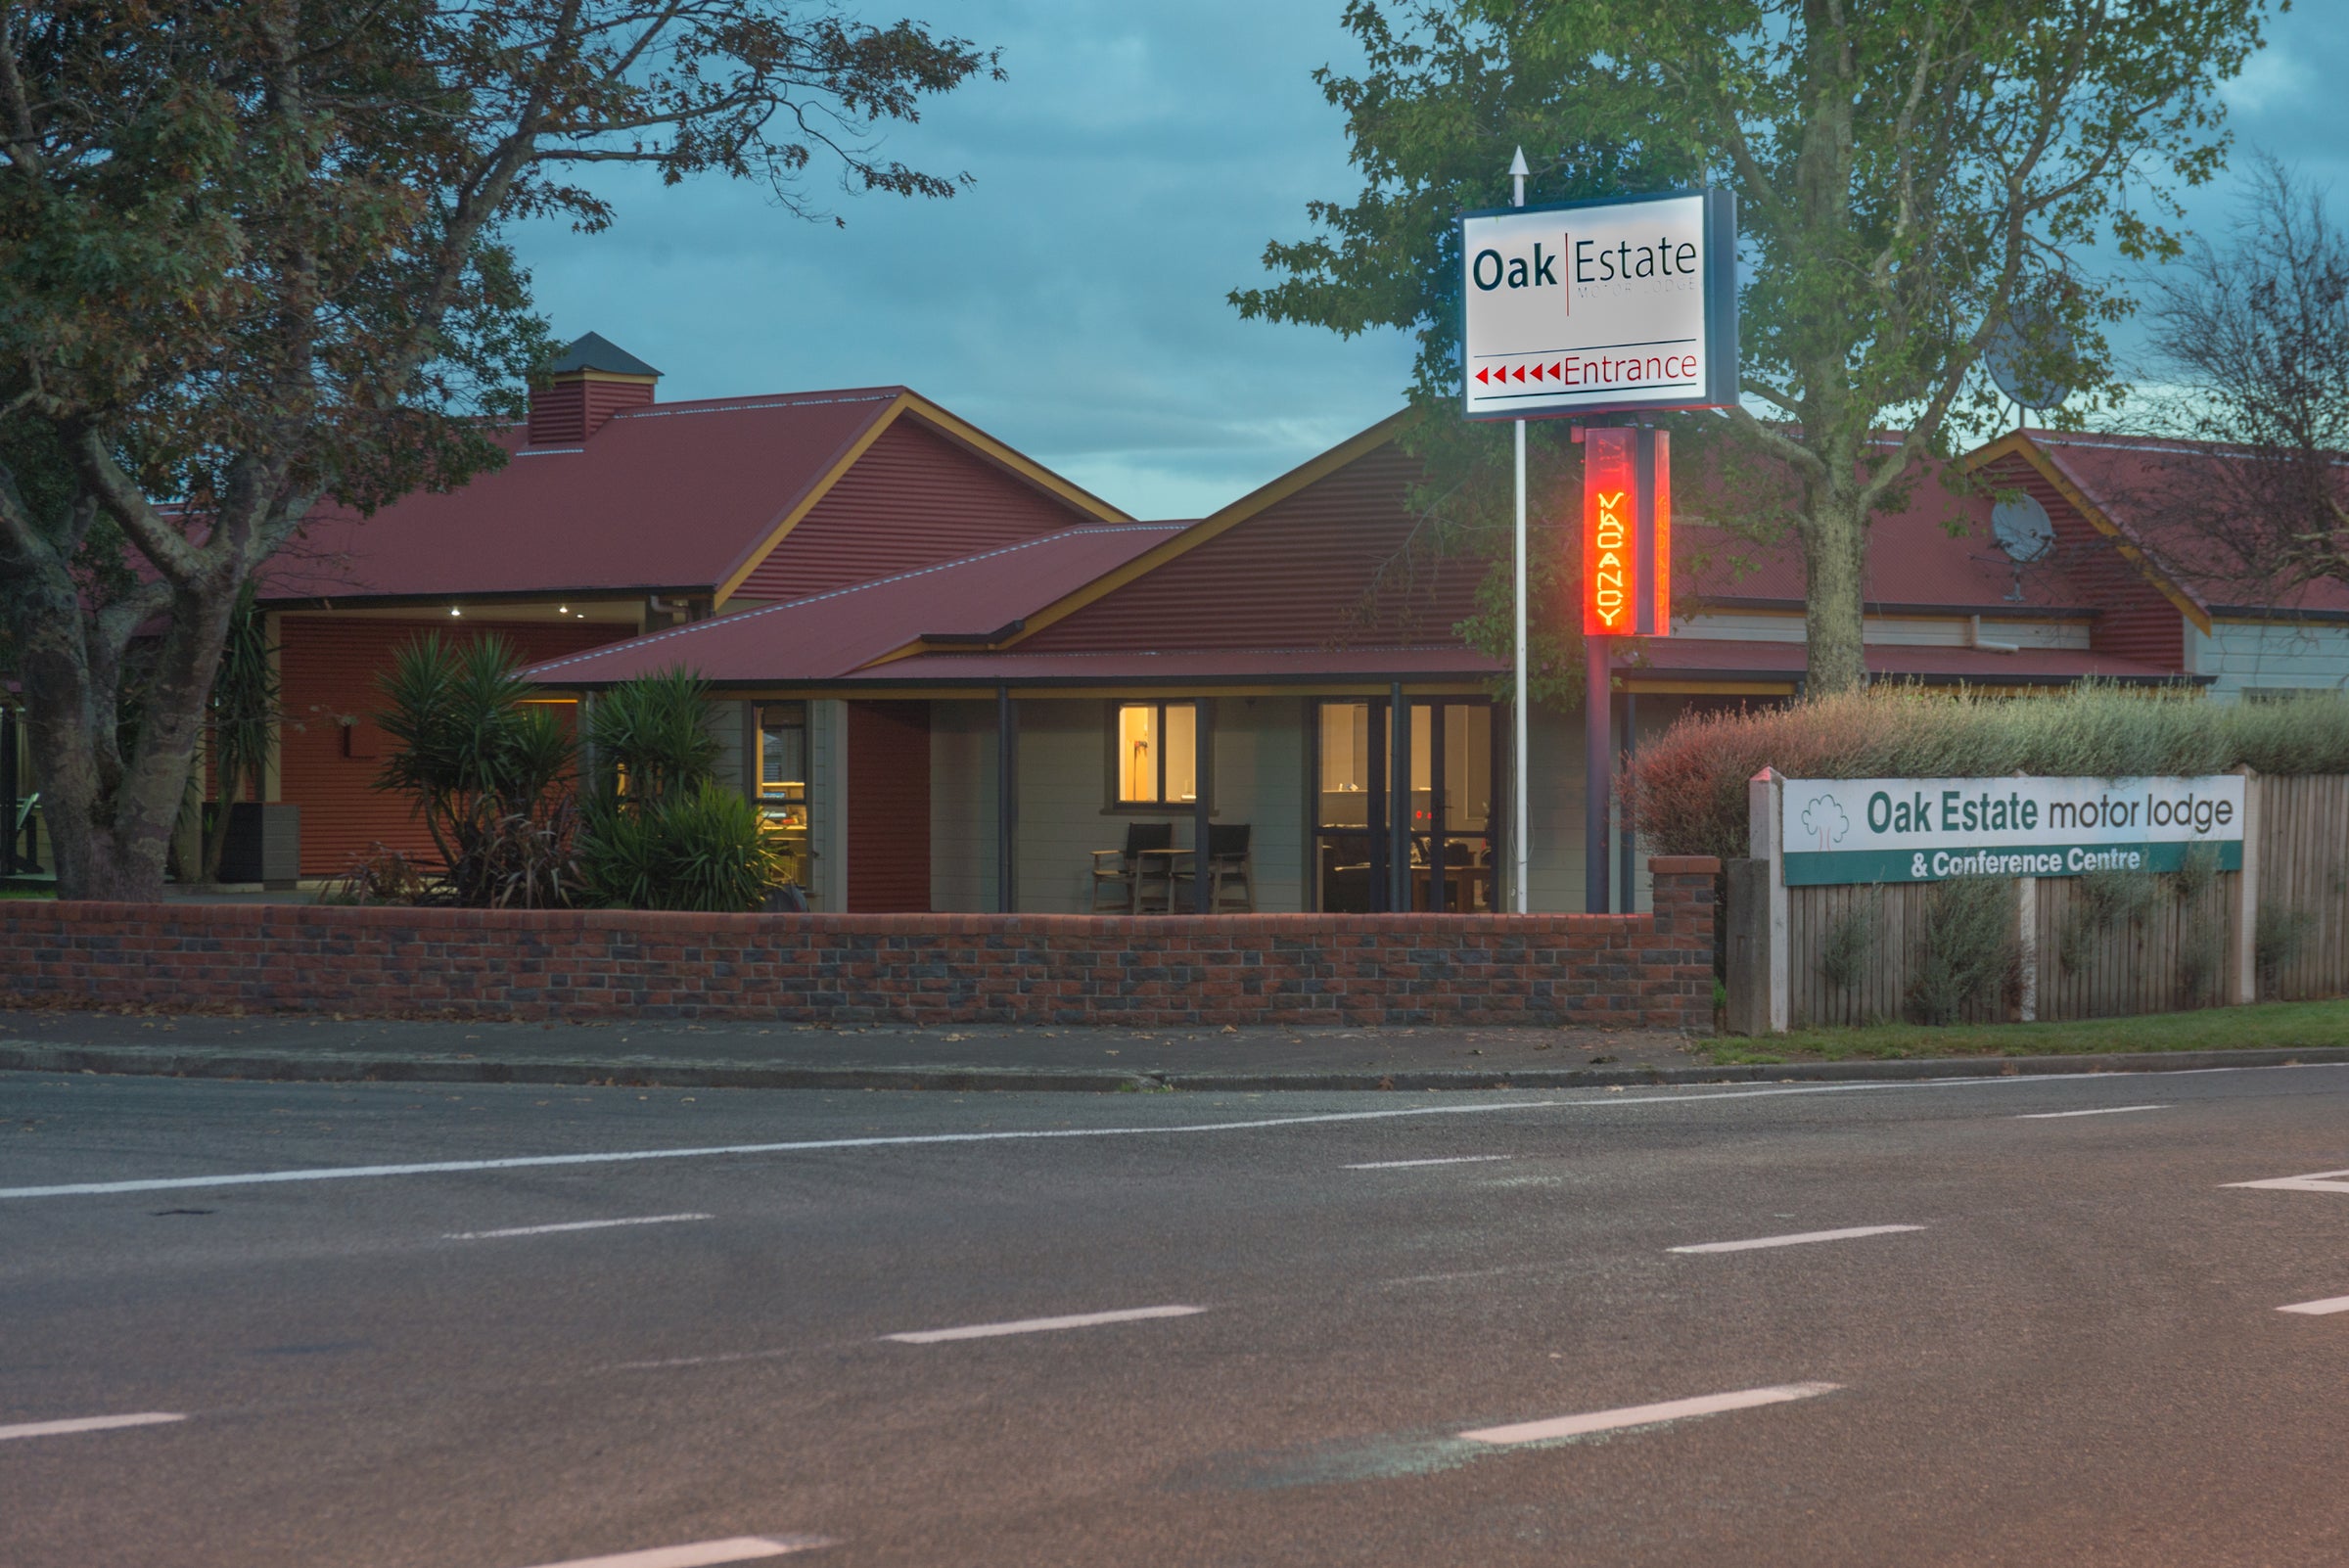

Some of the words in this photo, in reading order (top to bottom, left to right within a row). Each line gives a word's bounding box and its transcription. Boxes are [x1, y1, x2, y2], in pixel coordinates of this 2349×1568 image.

[1473, 242, 1558, 292] Oak
[1576, 237, 1697, 283] Estate
[1578, 283, 1633, 298] MOOR
[1643, 277, 1696, 294] ODGE
[1565, 354, 1697, 386] Entrance
[1597, 491, 1625, 626] VACANCY
[1867, 790, 1933, 834] Oak
[1942, 791, 2039, 832] Estate
[2050, 794, 2140, 828] motor
[2147, 793, 2234, 834] lodge
[1911, 852, 1928, 878] &
[1932, 850, 2063, 877] Conference
[2067, 847, 2142, 872] Centre
